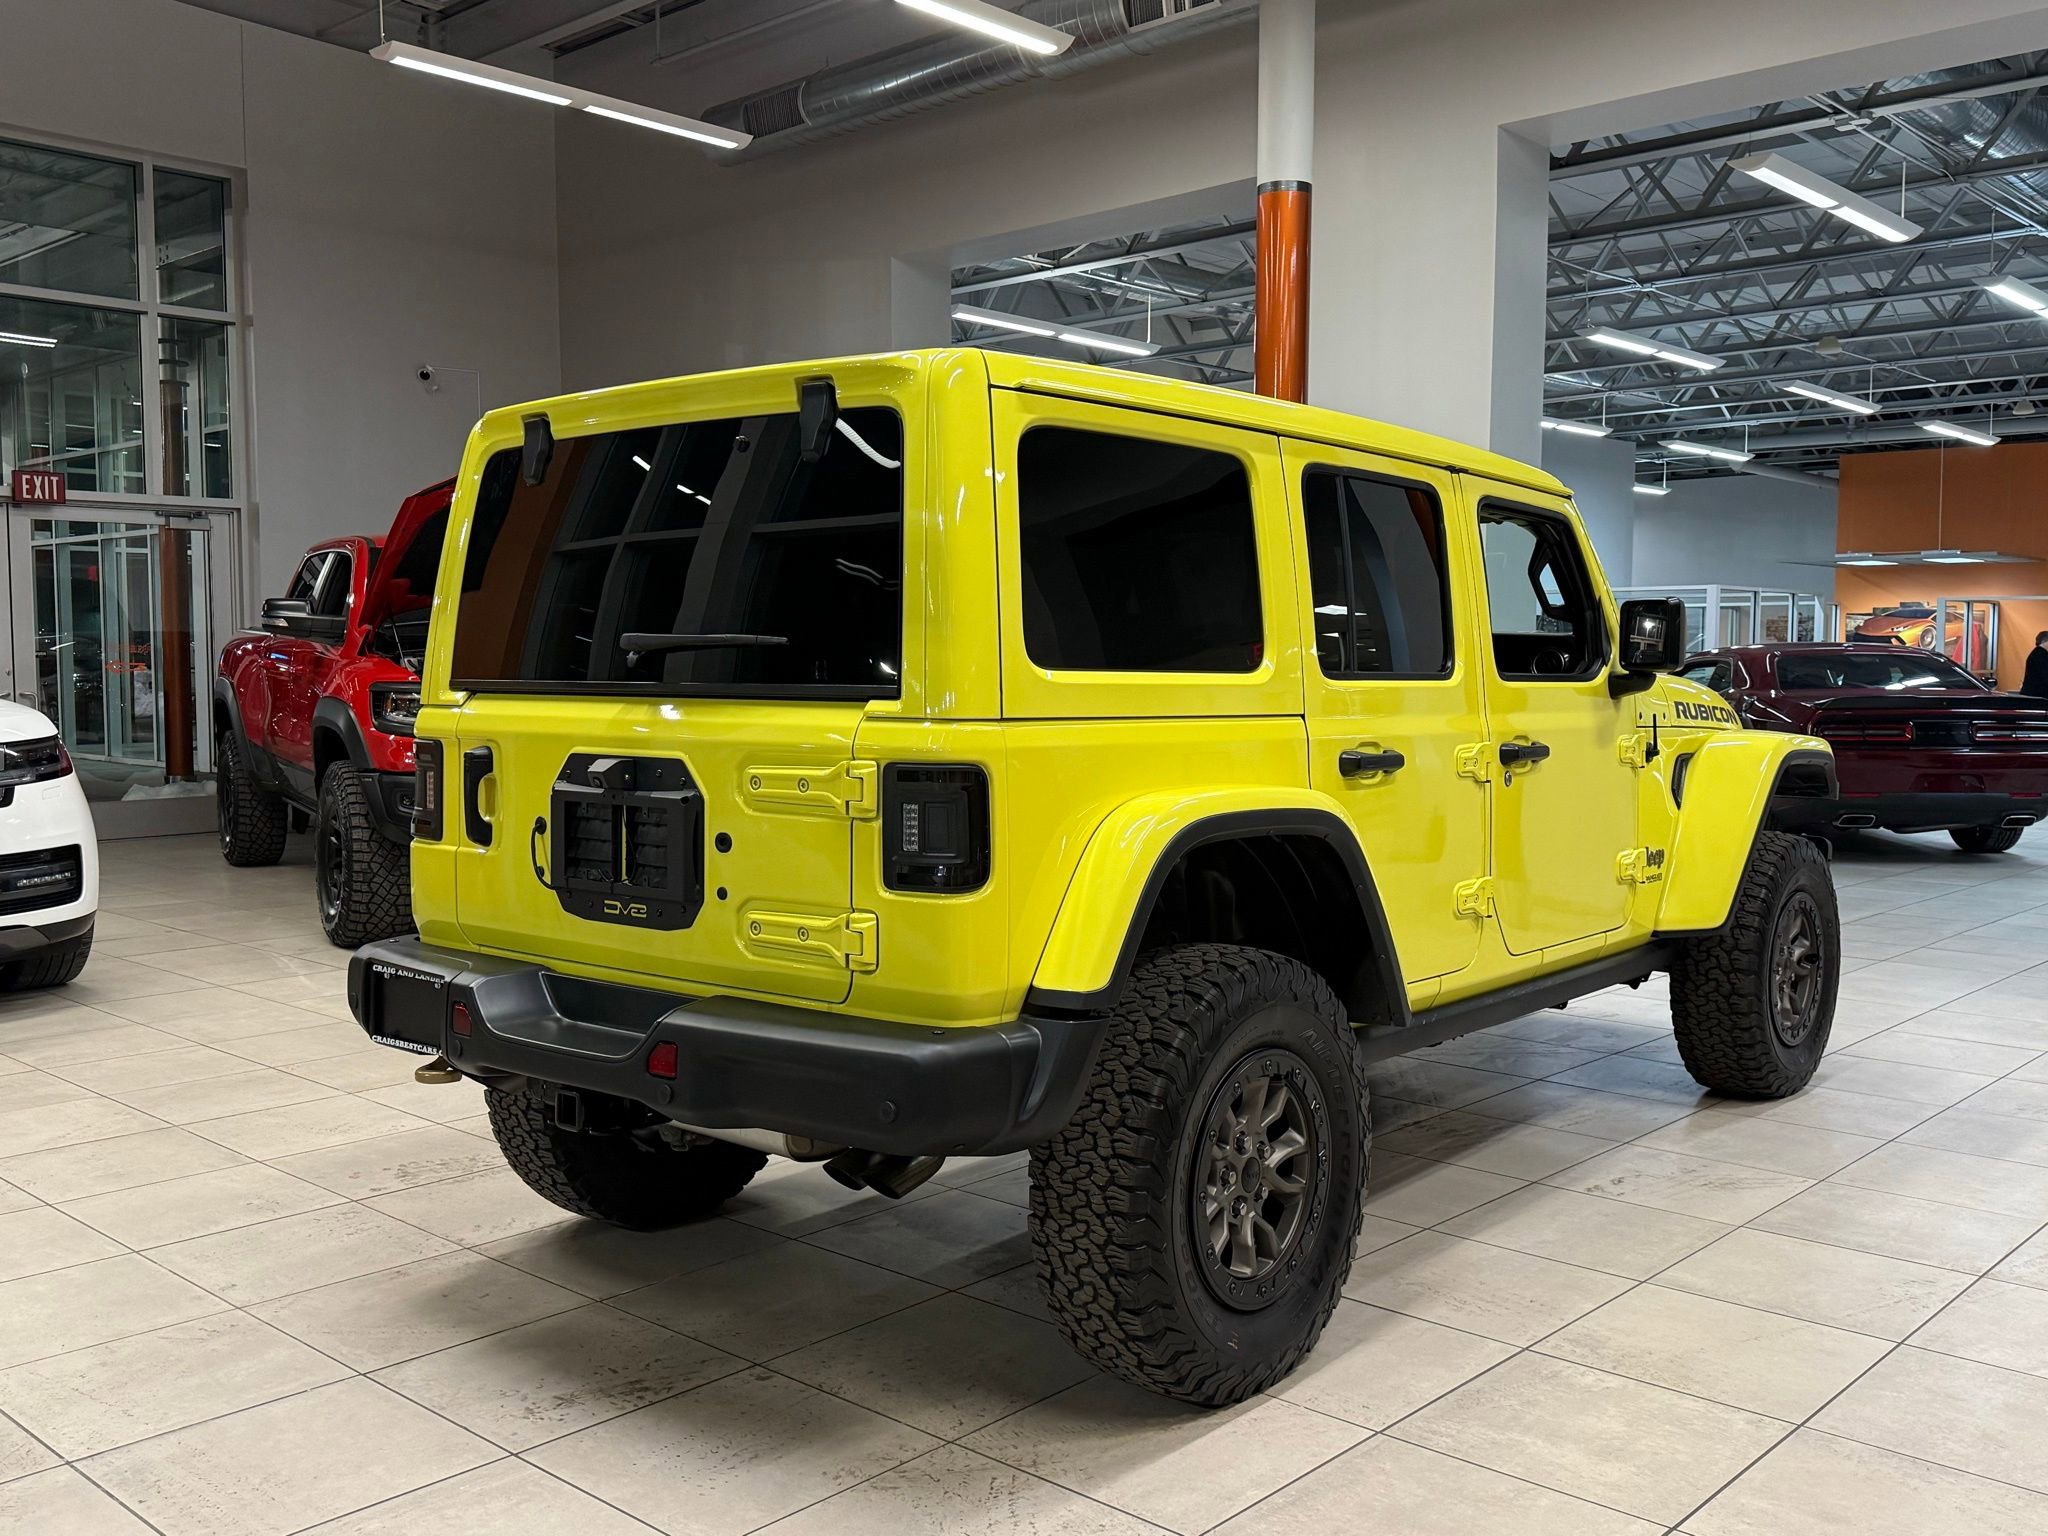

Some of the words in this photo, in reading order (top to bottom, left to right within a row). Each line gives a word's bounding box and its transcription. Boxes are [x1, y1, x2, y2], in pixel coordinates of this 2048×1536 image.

[22, 474, 59, 500] EXIT
[1674, 701, 1739, 726] RUBICON
[372, 964, 396, 974] CRAIG
[397, 969, 414, 978] AND
